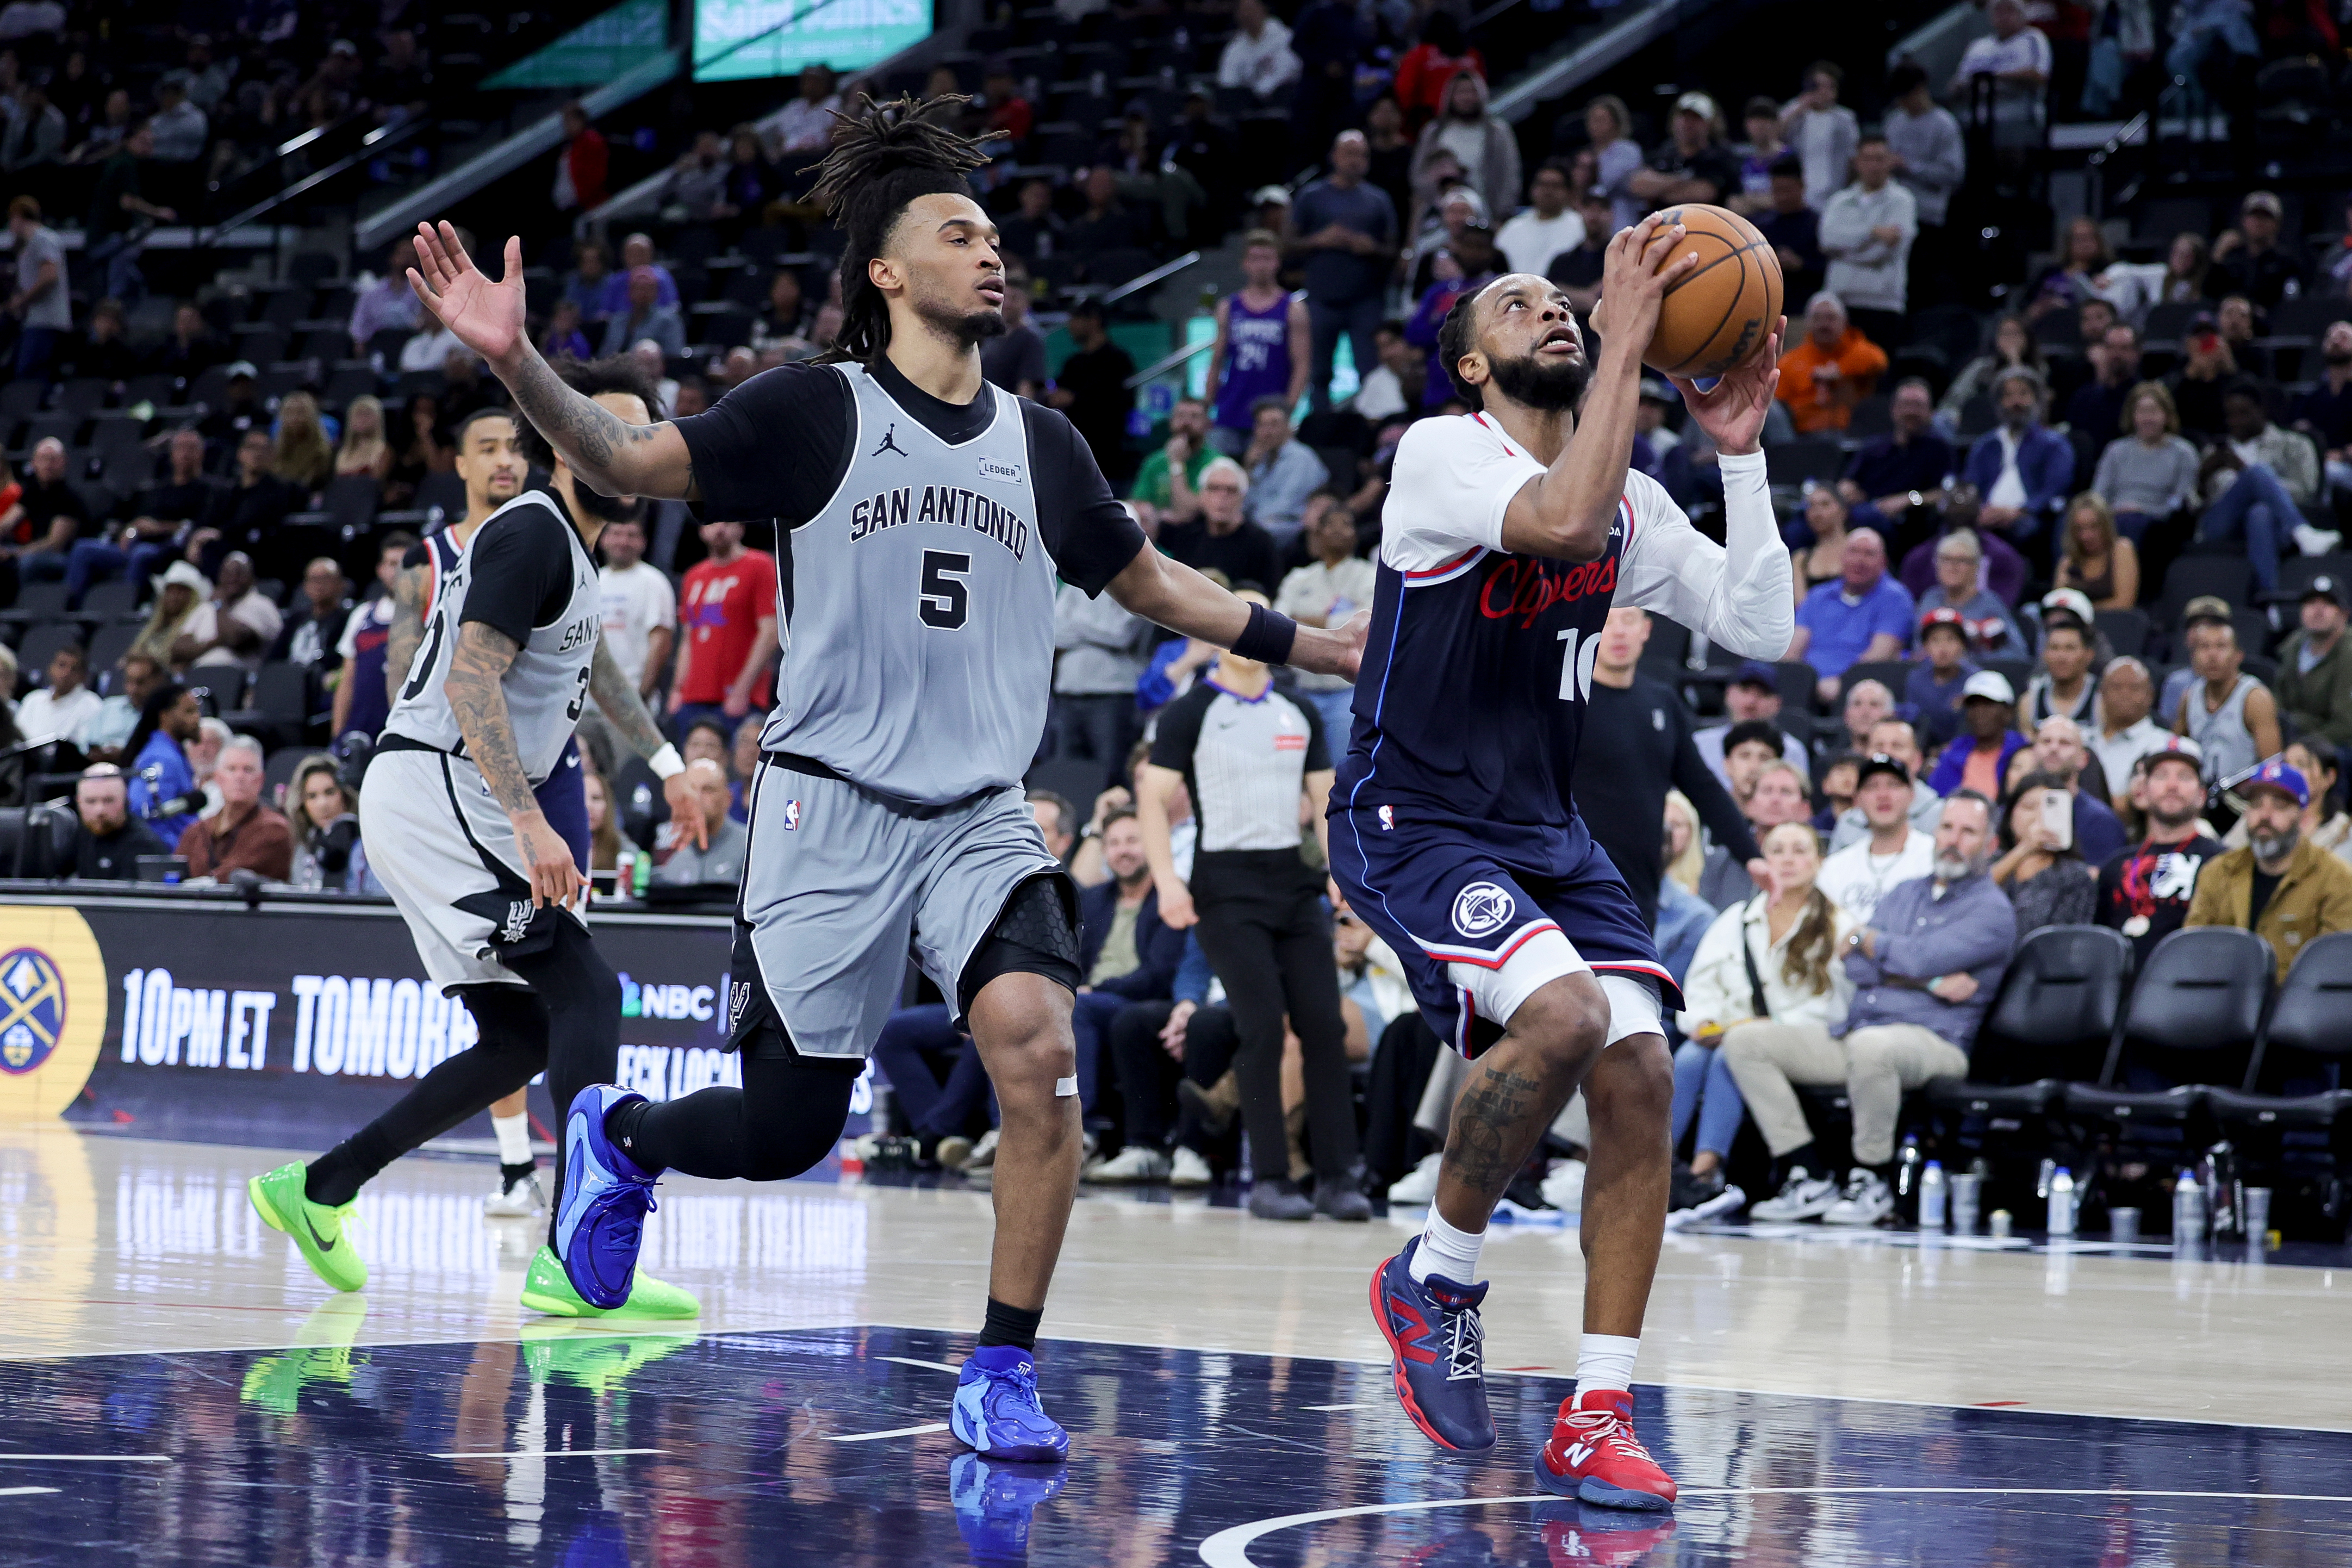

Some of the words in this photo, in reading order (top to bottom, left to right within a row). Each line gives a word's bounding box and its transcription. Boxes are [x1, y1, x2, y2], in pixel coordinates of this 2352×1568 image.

[985, 463, 1016, 477] LEDGER
[849, 486, 912, 544] SAN
[916, 484, 1028, 565] ANTONIO
[917, 547, 972, 631] 5
[1479, 556, 1617, 629] Clippers
[558, 615, 594, 652] SAN
[120, 968, 226, 1068] 10PM
[226, 990, 277, 1071] ET
[642, 983, 715, 1021] NBC
